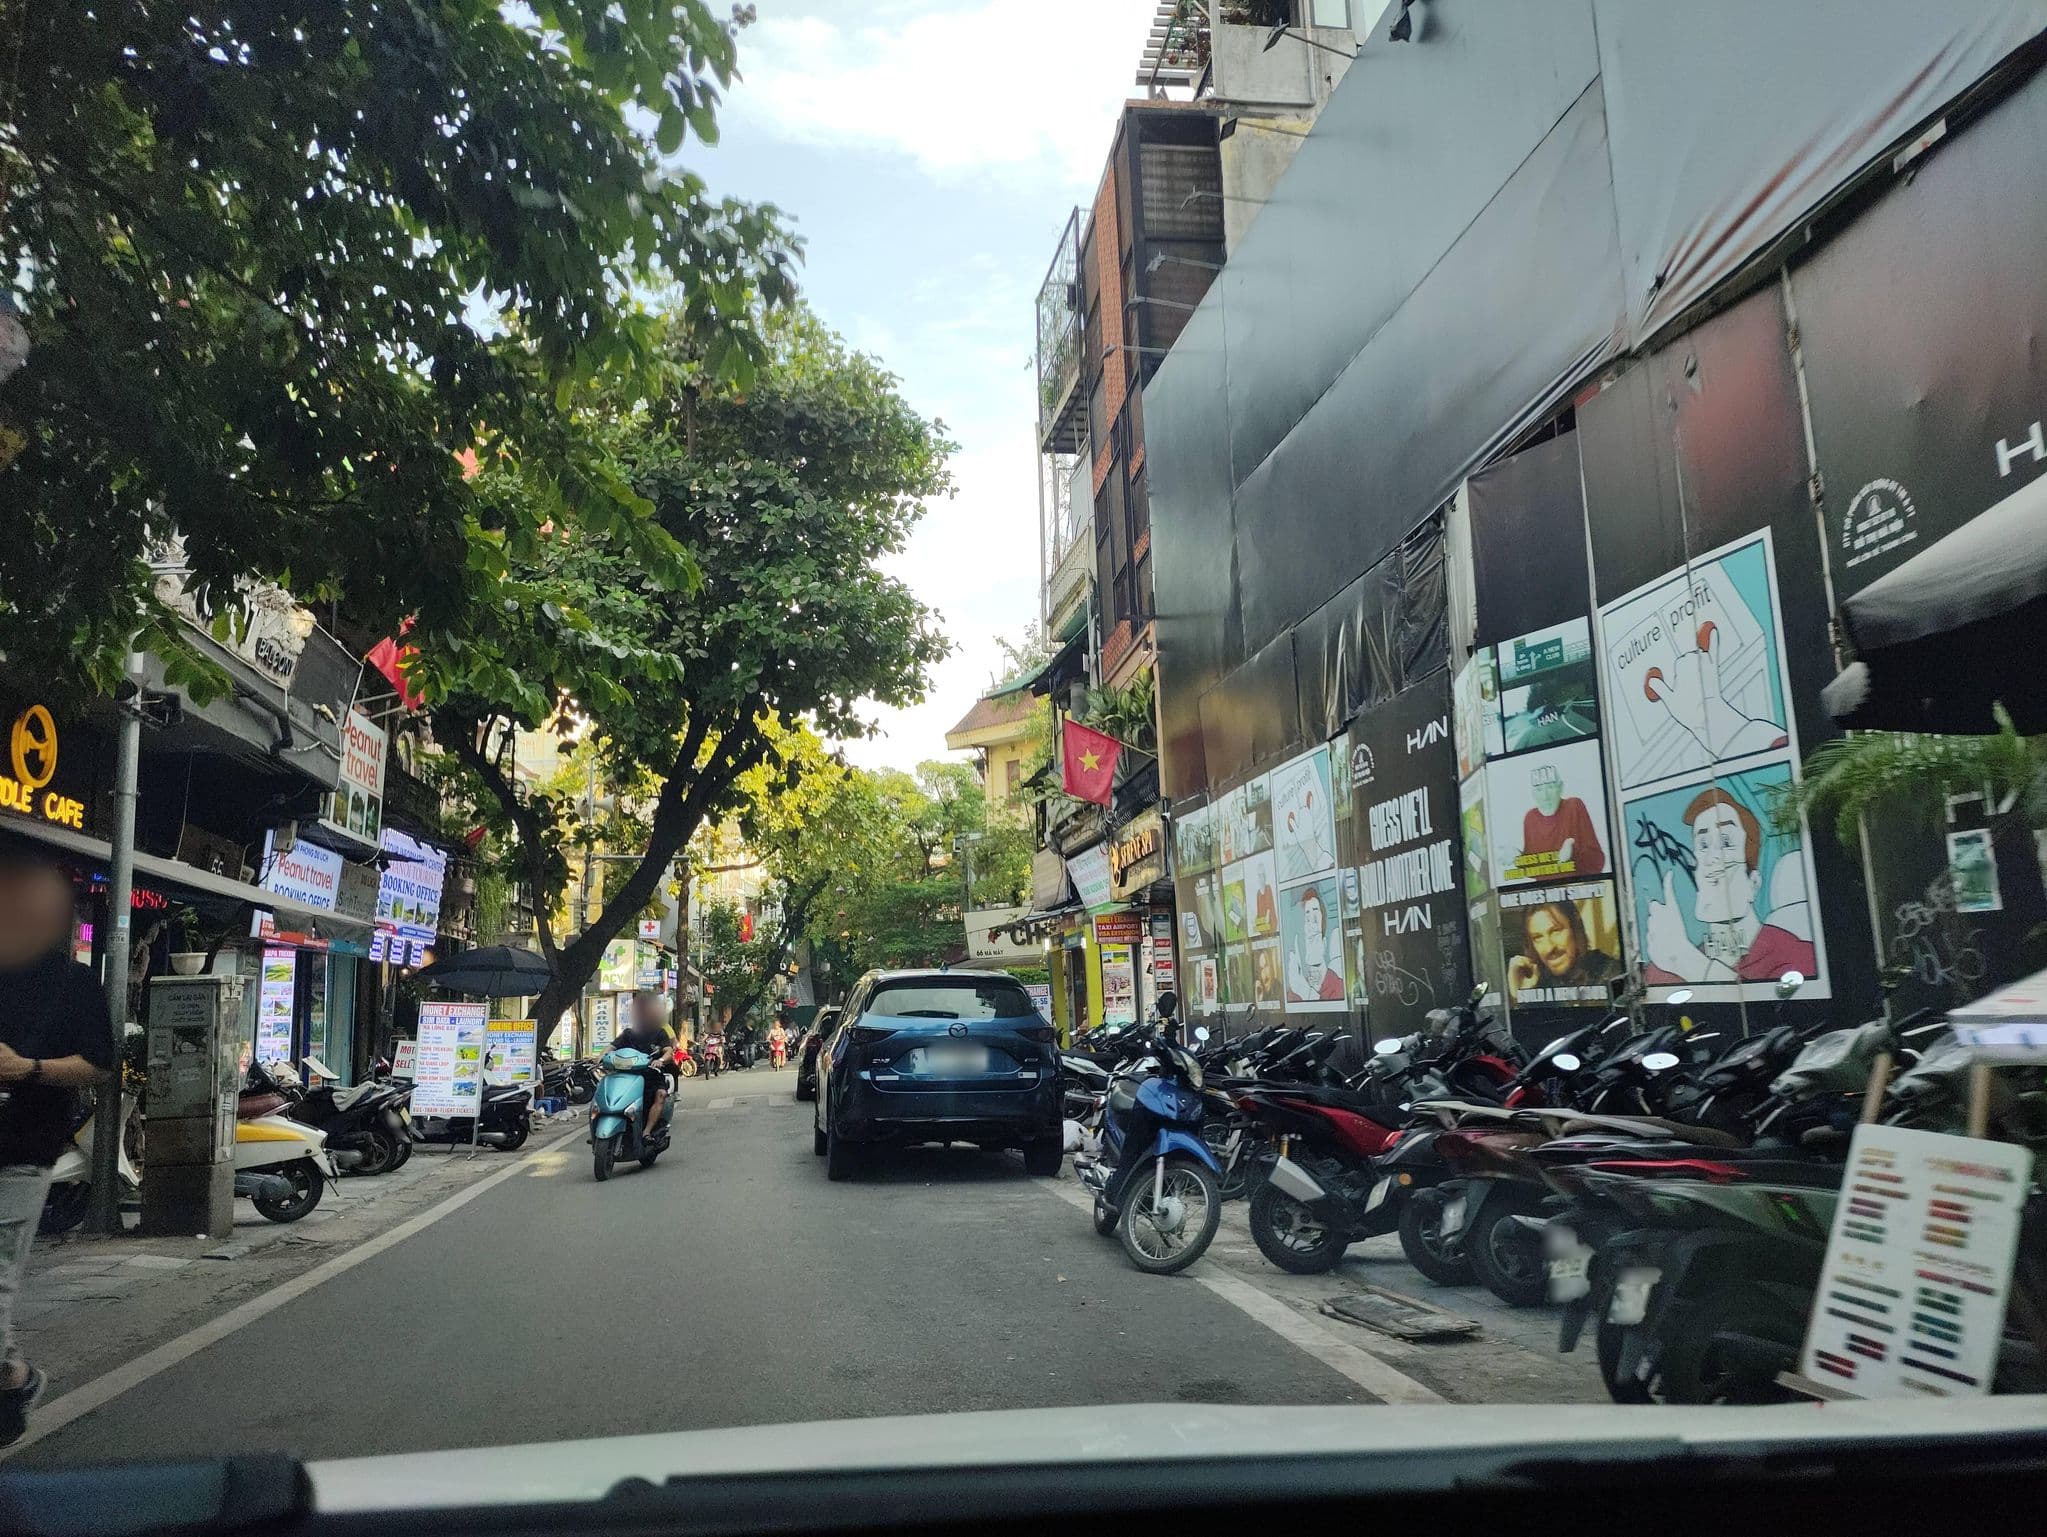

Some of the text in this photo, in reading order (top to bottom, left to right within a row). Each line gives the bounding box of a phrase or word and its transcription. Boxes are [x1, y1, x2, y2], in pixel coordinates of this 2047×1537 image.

[1995, 420, 2047, 478] H
[1617, 584, 1711, 670] culture profit
[1407, 715, 1448, 754] HAN
[1537, 711, 1559, 728] HAN
[346, 747, 378, 788] travel
[0, 776, 84, 828] DLE CAFE
[1369, 797, 1402, 852] GUESS
[278, 853, 334, 891] Peanut travel
[382, 873, 439, 904] BOOKING OFFICE
[1385, 846, 1433, 904] ANOTHER
[1428, 839, 1456, 893] ONE
[1383, 903, 1433, 936] HAN
[422, 1004, 486, 1017] MONEY EXCHANGE
[400, 1045, 416, 1055] MOT
